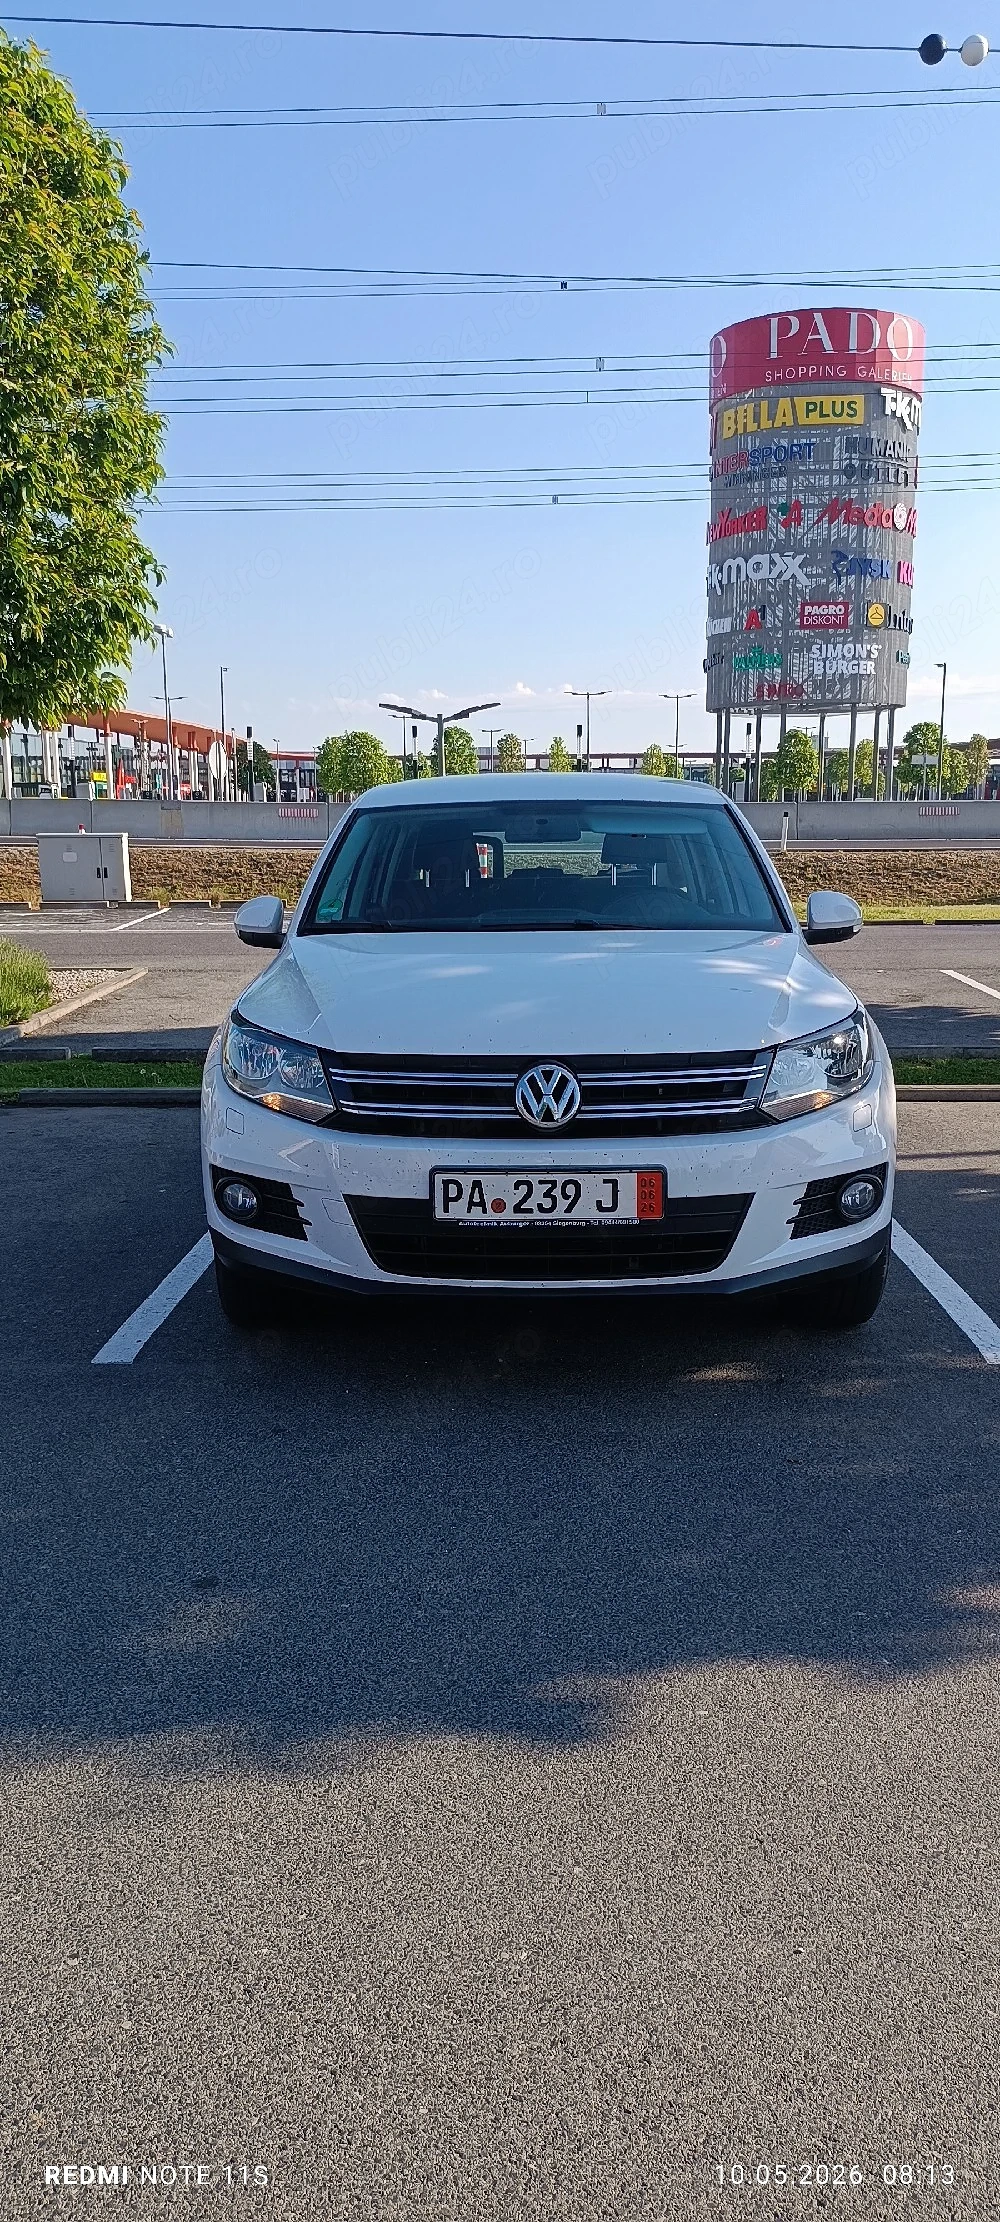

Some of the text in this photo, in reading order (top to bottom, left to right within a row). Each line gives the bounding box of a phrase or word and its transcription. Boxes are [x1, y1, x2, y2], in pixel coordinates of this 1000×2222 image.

[764, 311, 913, 361] PADO
[765, 365, 847, 382] SHOPPING
[722, 397, 795, 440] BILLA
[805, 401, 858, 419] PLUS
[846, 558, 891, 579] JYSK
[804, 604, 845, 616] PAGRO
[803, 615, 845, 626] DISKONT
[810, 643, 880, 660] SIMON'S
[813, 660, 877, 675] BURGER
[640, 1177, 656, 1188] 06
[441, 1178, 620, 1214] PA 239 J
[640, 1189, 656, 1200] 06
[640, 1202, 656, 1213] 26
